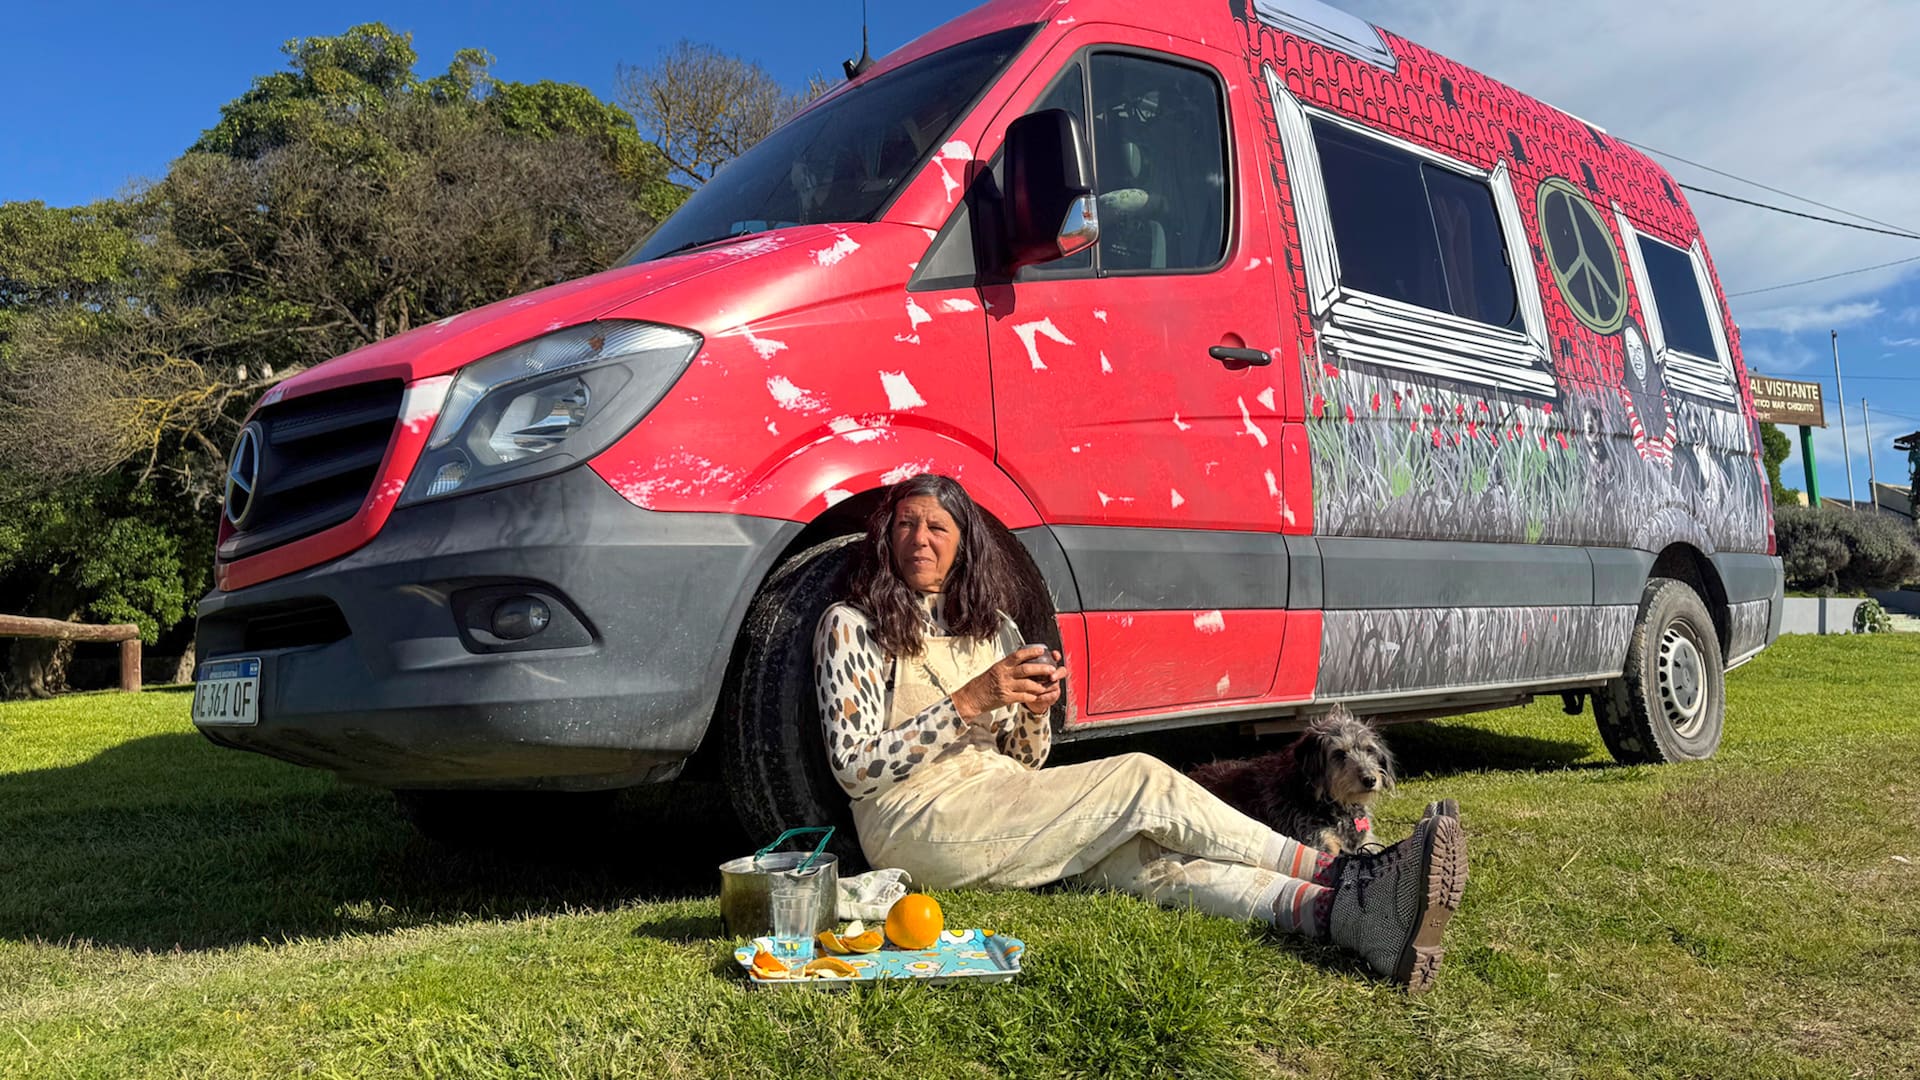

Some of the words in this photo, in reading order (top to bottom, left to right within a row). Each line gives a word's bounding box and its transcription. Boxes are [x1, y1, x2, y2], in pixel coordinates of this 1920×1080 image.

[1750, 379, 1763, 395] AL
[1765, 381, 1819, 400] VISITANTE
[1753, 399, 1770, 408] NTICO
[1772, 400, 1785, 410] MAR
[207, 682, 229, 717] 361
